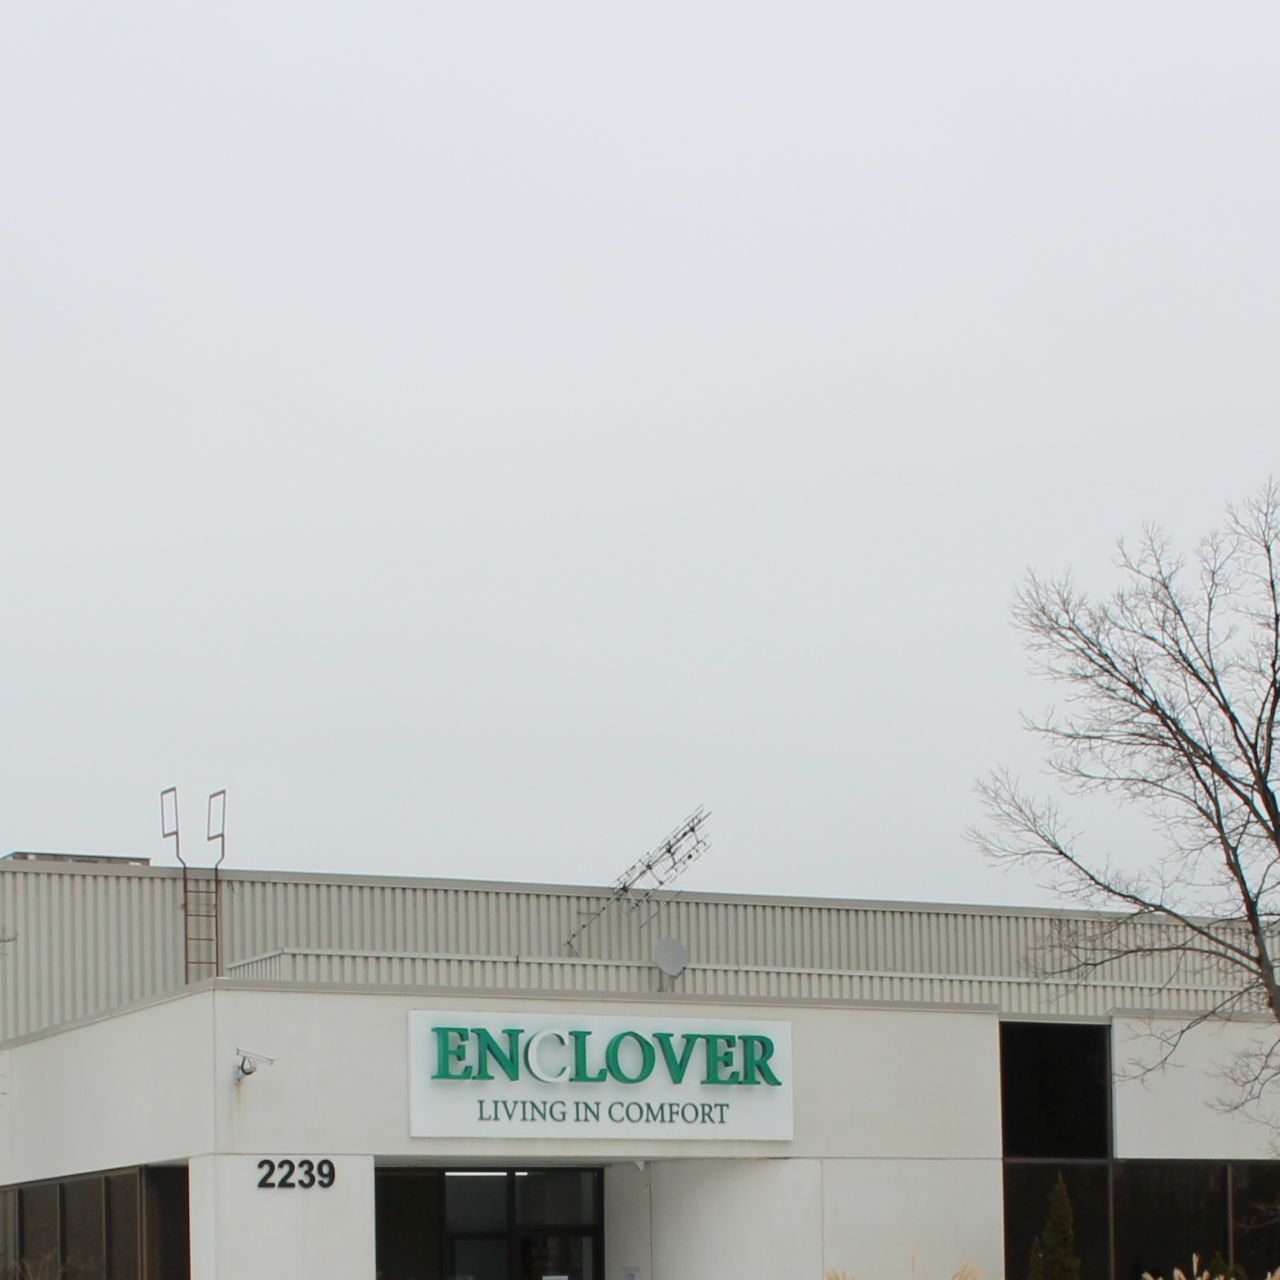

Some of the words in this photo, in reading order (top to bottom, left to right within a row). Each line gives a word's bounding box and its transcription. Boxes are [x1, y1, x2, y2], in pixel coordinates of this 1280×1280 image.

[431, 1027, 782, 1086] ENCLOVER
[477, 1100, 567, 1122] LIVING
[574, 1102, 601, 1122] IN
[608, 1102, 730, 1124] COMFORT
[257, 1159, 335, 1188] 2239
